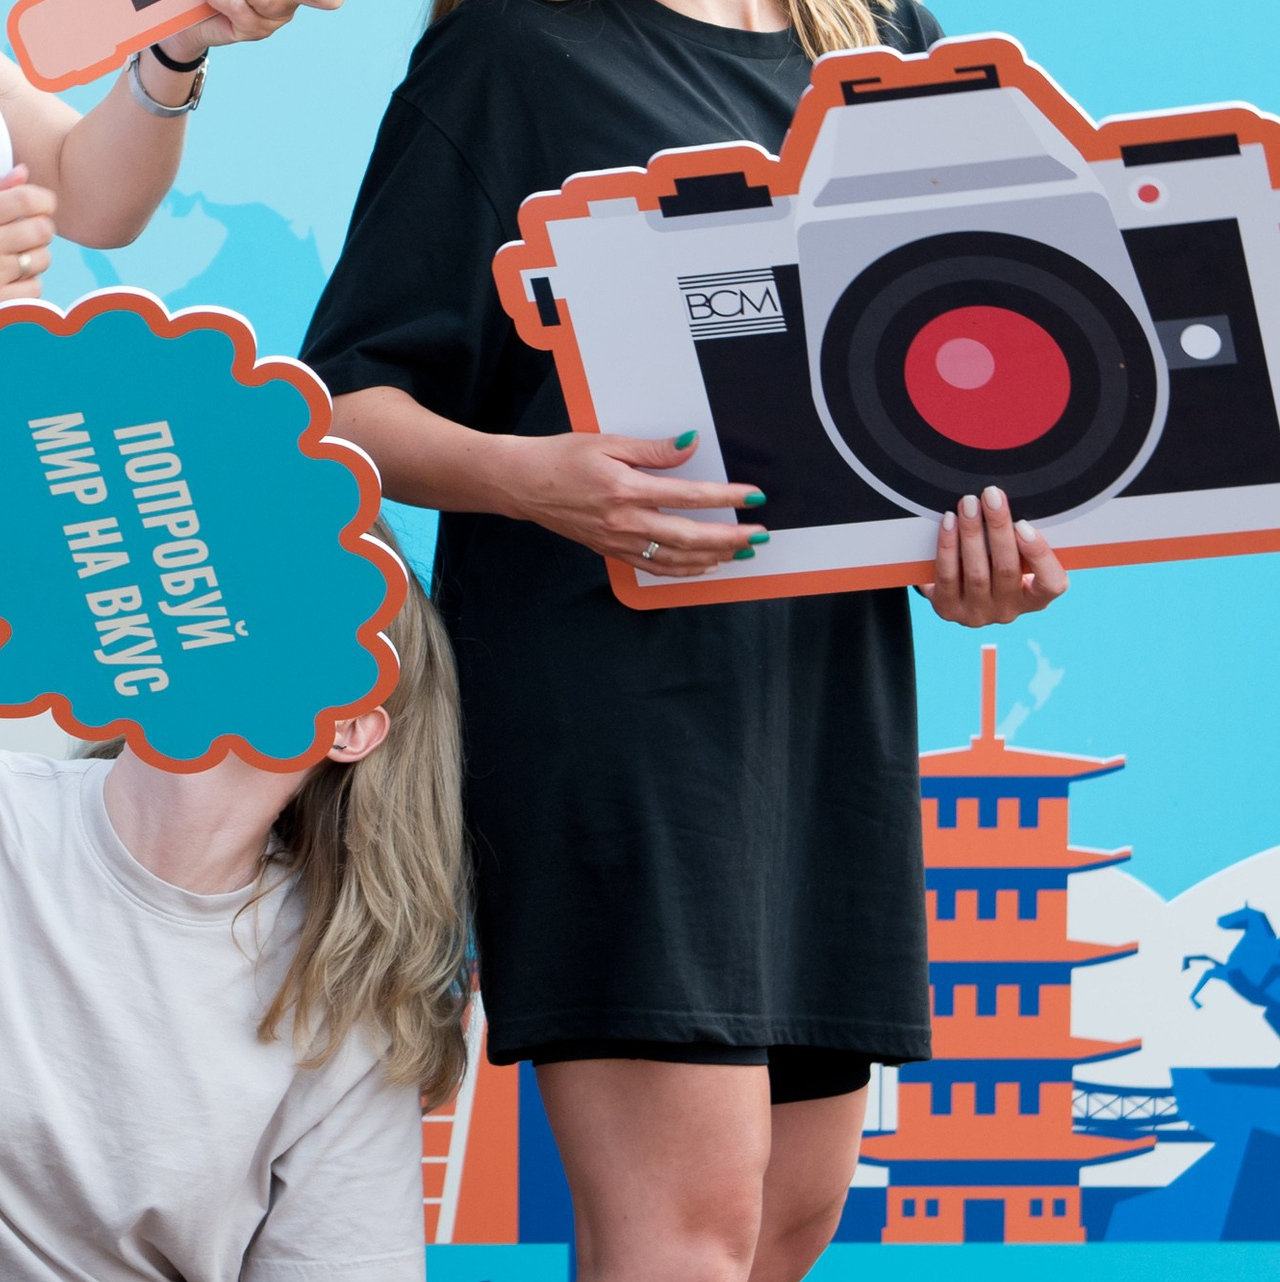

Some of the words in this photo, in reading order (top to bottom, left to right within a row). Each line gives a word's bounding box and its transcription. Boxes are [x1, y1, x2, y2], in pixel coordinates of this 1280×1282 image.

[28, 412, 108, 505] МИР
[62, 517, 130, 579] НА
[113, 420, 249, 651] ПОПРОБУЙ
[85, 585, 170, 697] ВКУС
